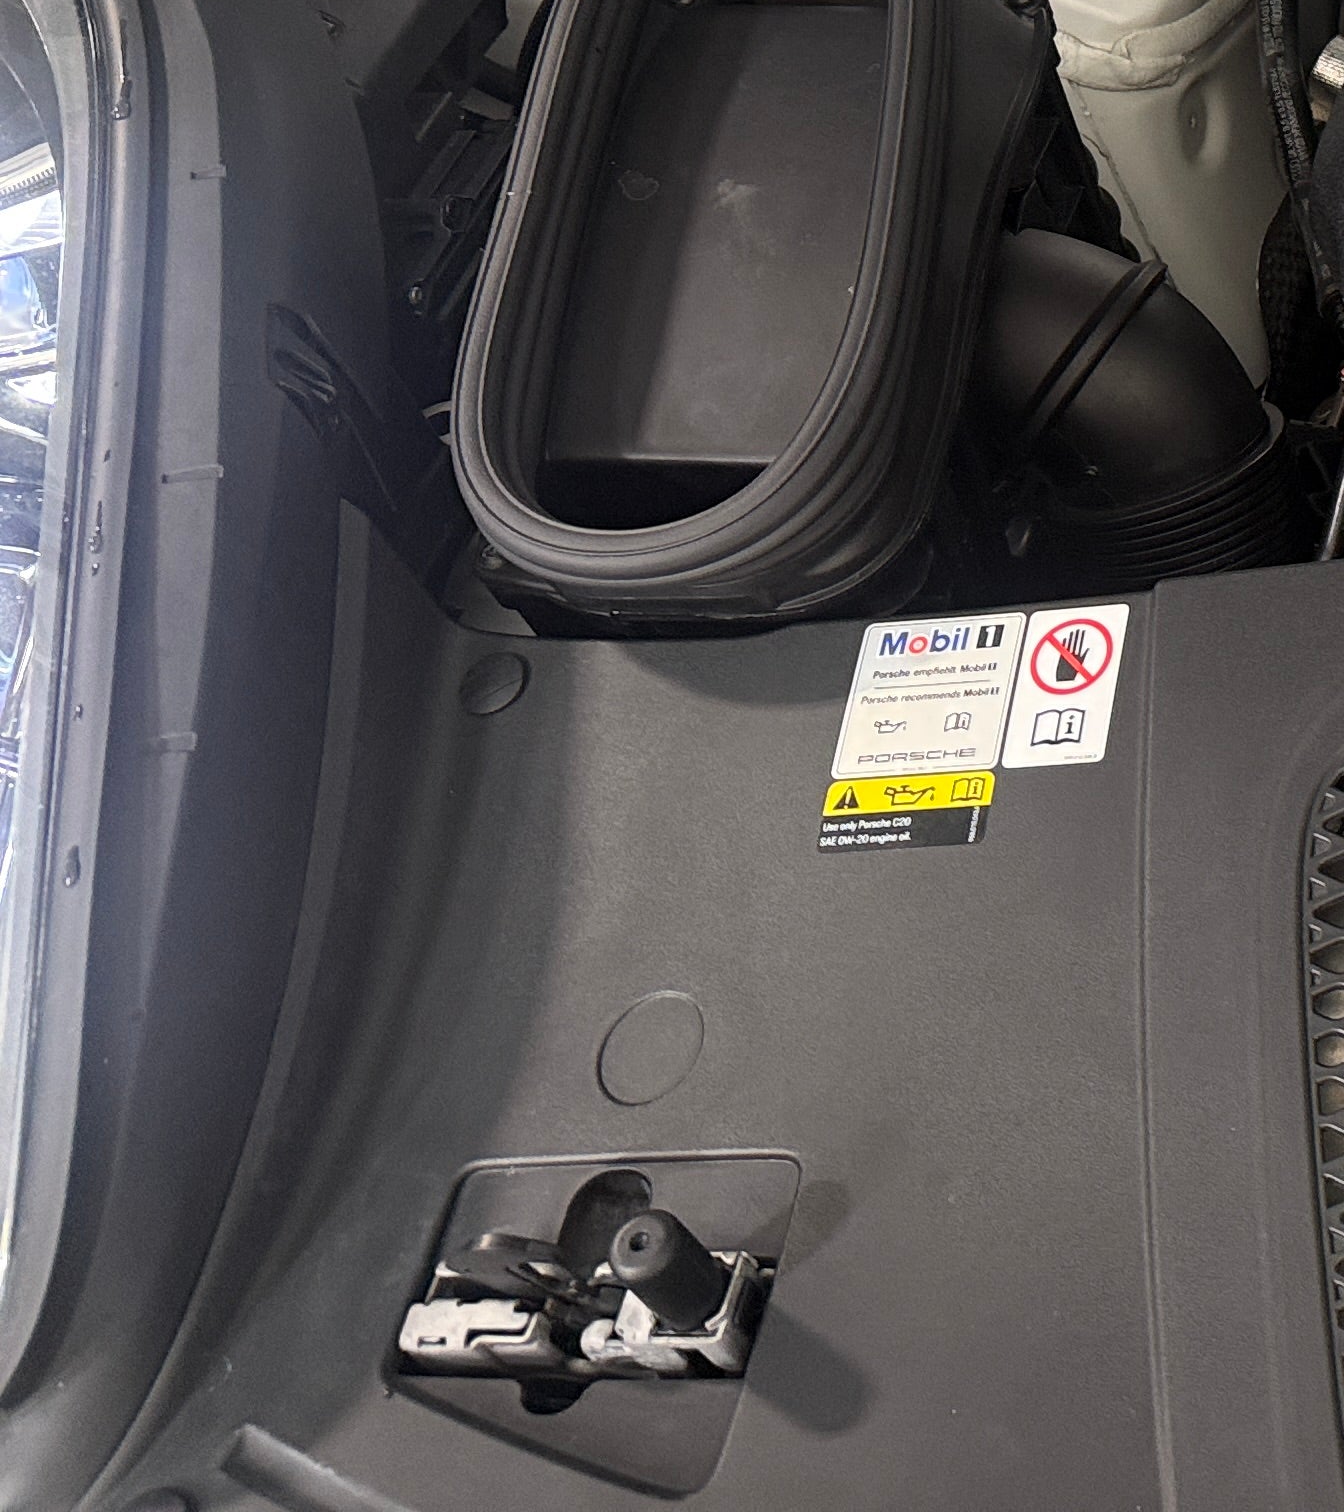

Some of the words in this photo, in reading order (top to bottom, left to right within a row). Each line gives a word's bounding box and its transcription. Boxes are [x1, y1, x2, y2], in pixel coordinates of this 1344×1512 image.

[879, 627, 970, 656] Mobil
[873, 669, 910, 679] Porsche
[913, 666, 957, 677] empfiehlt
[960, 663, 986, 672] Mobil
[860, 695, 898, 705] Porsche
[901, 690, 961, 702] recommends
[963, 688, 989, 697] Mobil
[857, 747, 976, 765] PORSCHE
[822, 822, 839, 833] Use
[839, 820, 858, 832] only
[858, 819, 892, 830] Porsche
[892, 816, 912, 827] C20
[819, 835, 837, 847] SAE
[837, 833, 869, 845] 0W-20
[869, 832, 897, 844] engine
